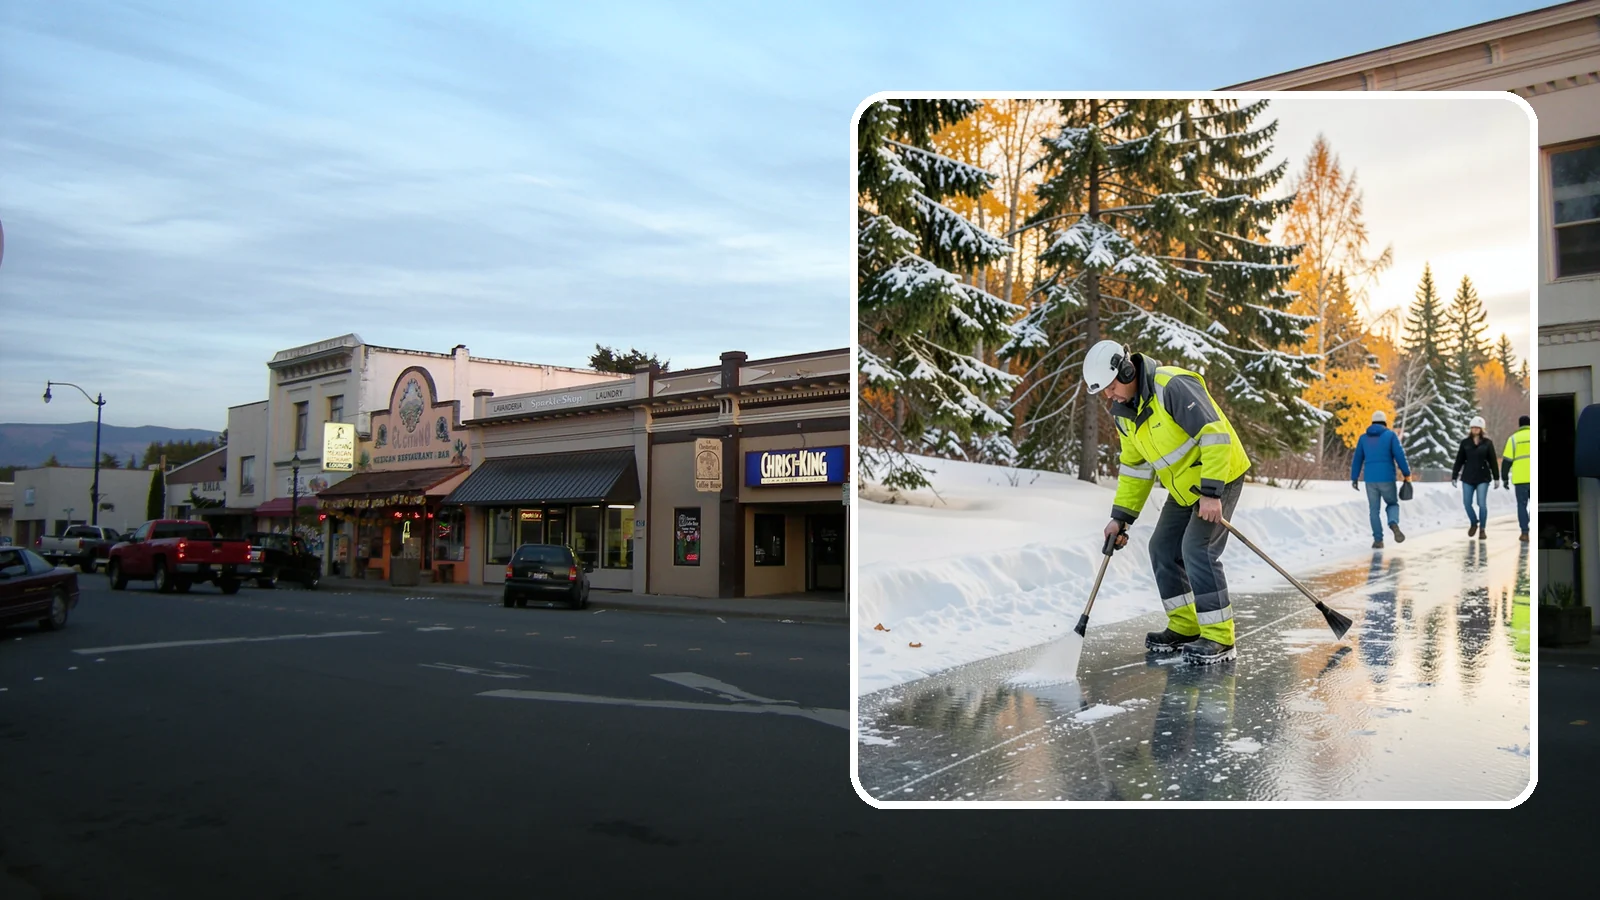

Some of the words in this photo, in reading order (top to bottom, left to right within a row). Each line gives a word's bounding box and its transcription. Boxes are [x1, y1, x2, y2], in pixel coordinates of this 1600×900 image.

[561, 394, 582, 407] Shop
[596, 389, 623, 400] LAUNDRY
[493, 402, 522, 412] LAVANDERIA
[397, 452, 433, 462] RESTAURANT
[438, 450, 450, 458] BAR
[761, 452, 797, 478] CHRIST
[799, 450, 827, 476] KING
